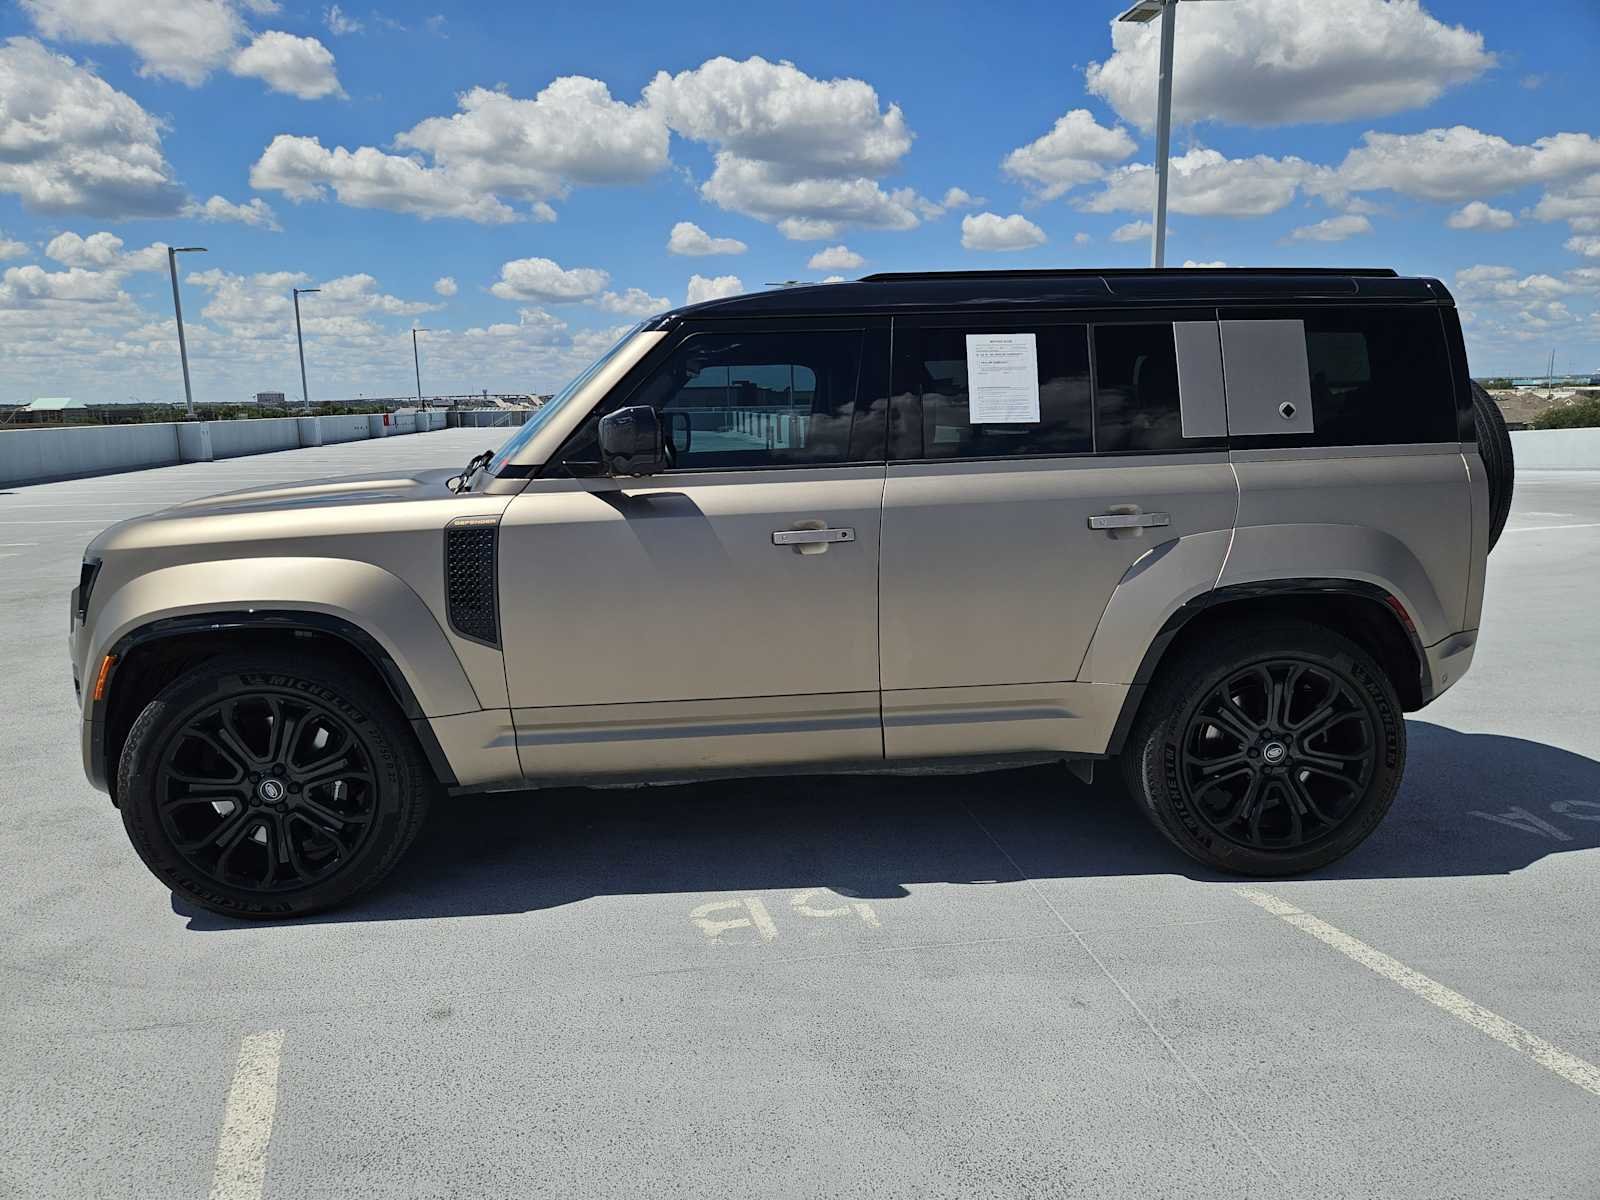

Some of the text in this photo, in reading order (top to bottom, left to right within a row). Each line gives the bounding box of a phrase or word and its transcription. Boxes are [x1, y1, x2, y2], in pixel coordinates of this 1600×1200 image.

[268, 674, 367, 724] MICHELIN
[1368, 684, 1397, 768] MICHELIN
[1166, 747, 1197, 830] MICHELIN
